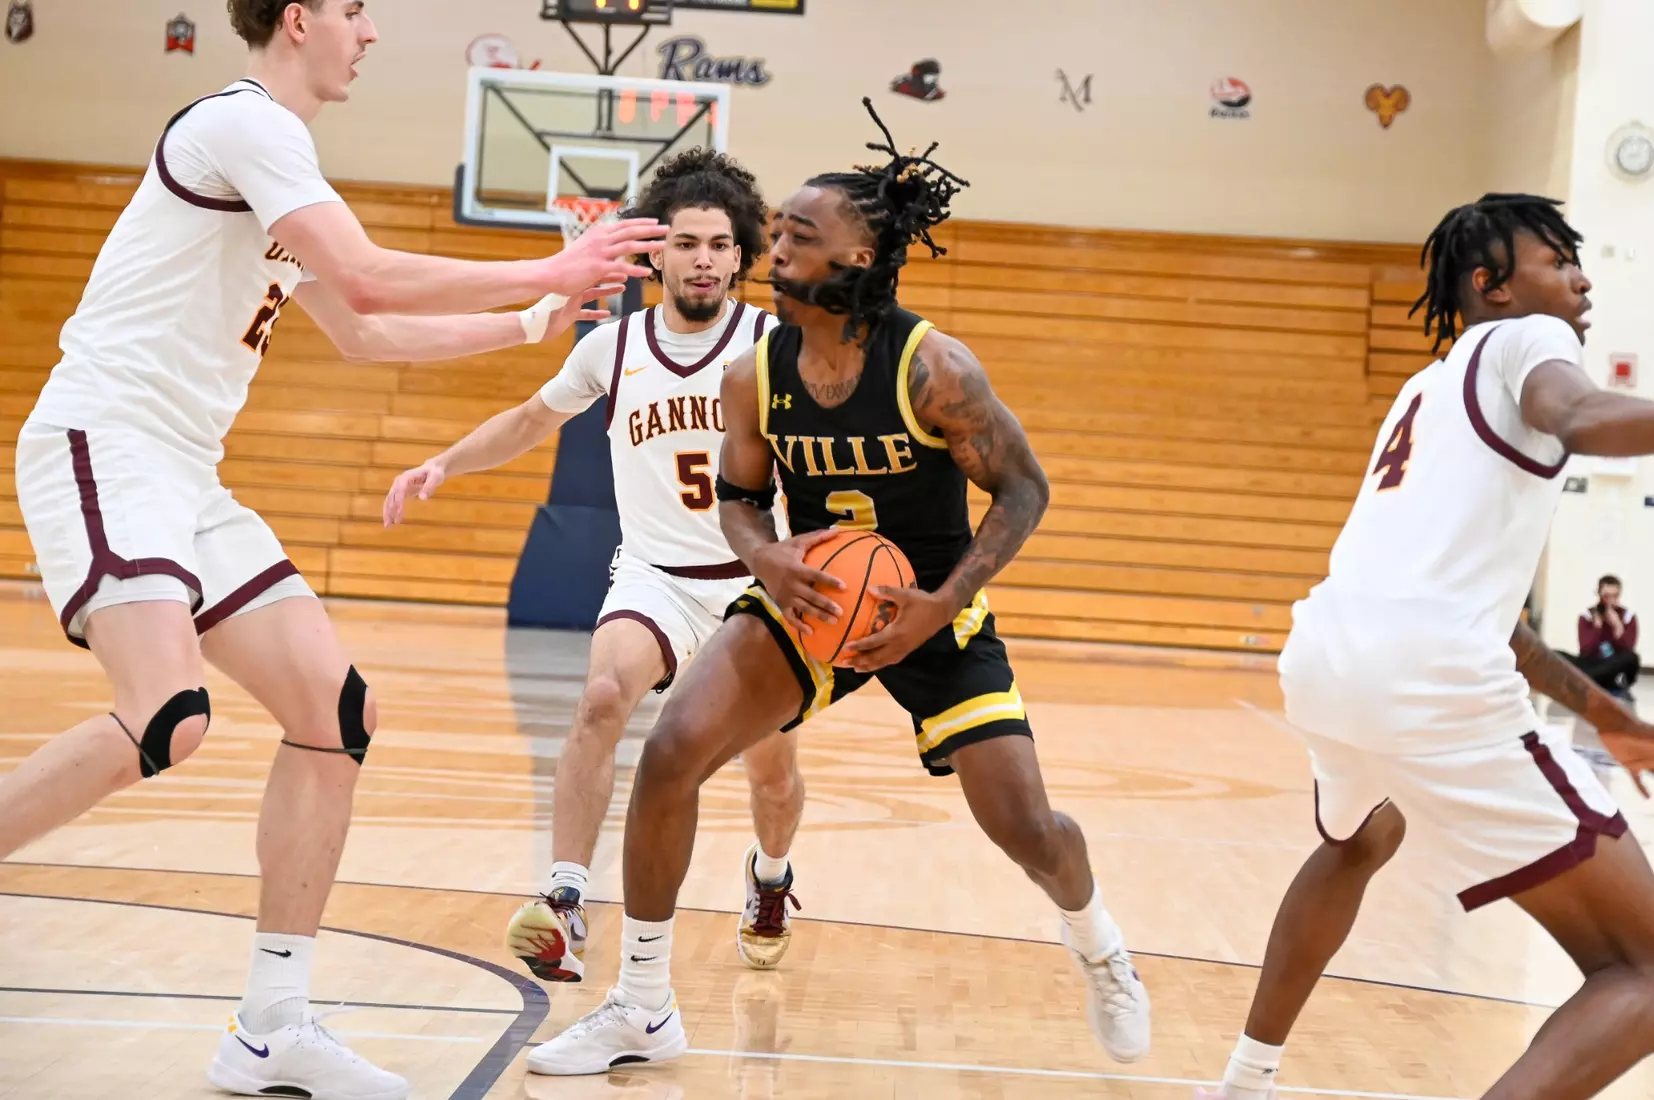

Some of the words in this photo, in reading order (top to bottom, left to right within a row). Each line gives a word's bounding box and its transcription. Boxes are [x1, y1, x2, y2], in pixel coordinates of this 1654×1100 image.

[656, 35, 773, 88] Rams
[767, 433, 918, 477] VILLE
[1371, 391, 1423, 494] 4
[674, 451, 716, 513] 5
[826, 489, 879, 532] 2
